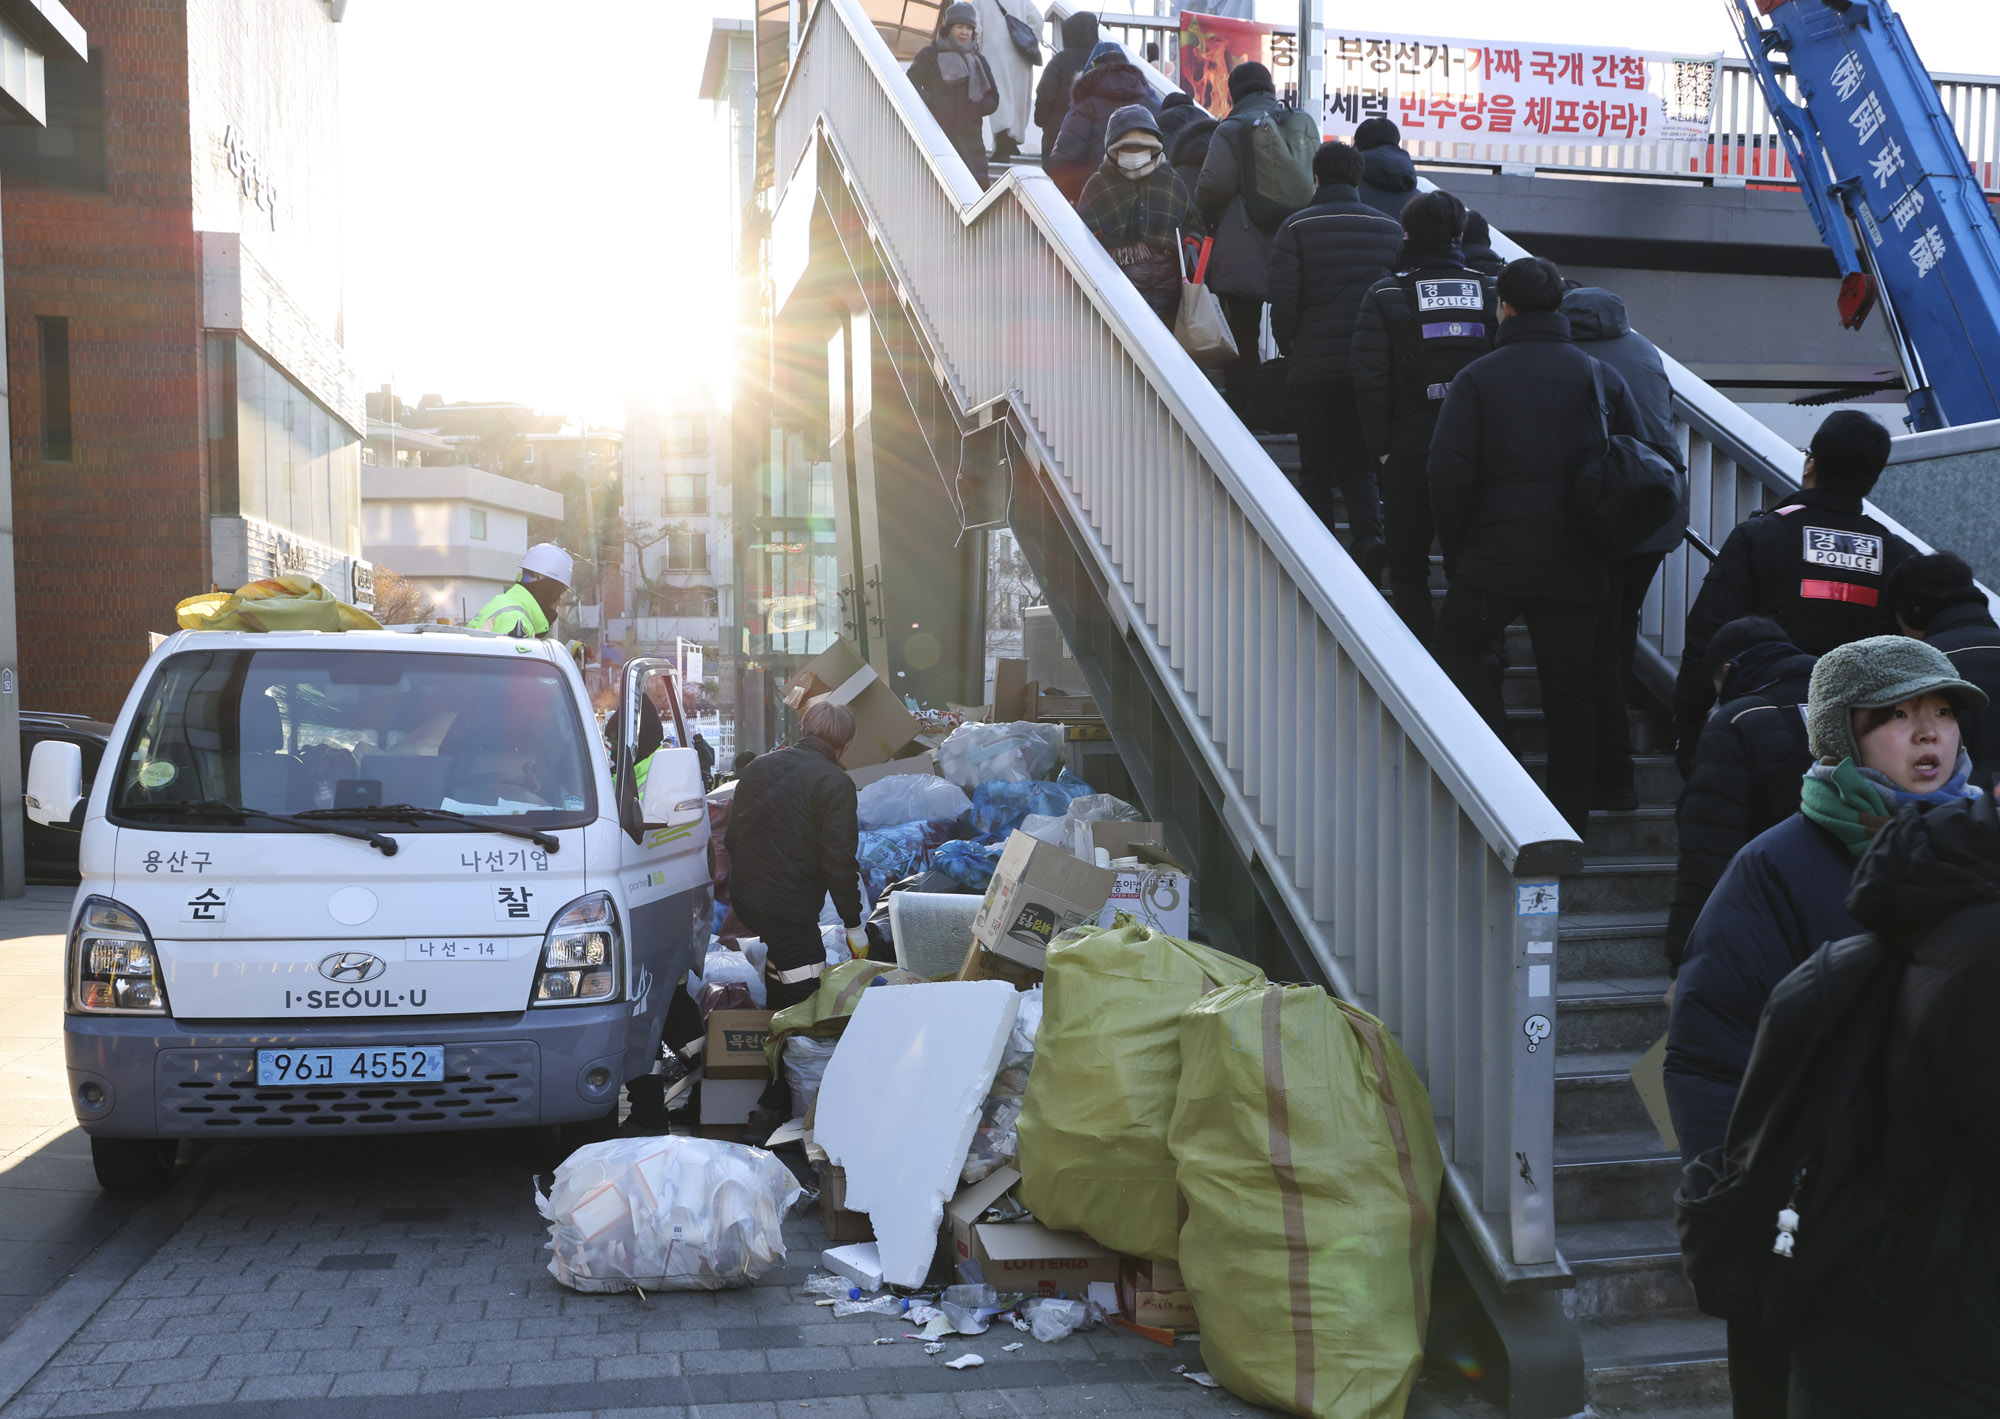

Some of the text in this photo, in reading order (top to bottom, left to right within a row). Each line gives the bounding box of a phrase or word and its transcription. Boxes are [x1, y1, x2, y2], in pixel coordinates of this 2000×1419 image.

[1530, 51, 1584, 87] 국개
[1592, 54, 1645, 91] 간첩
[1399, 89, 1517, 134] 민주당을
[1523, 97, 1648, 139] 체포하라!
[1427, 297, 1476, 307] POLICE
[1816, 551, 1872, 569] POLICE
[142, 850, 213, 873] 용산구
[461, 849, 549, 873] 나선기업
[187, 887, 226, 919] 순
[498, 886, 533, 918] 찰
[275, 1052, 333, 1081] 96고
[350, 1051, 427, 1079] 4552
